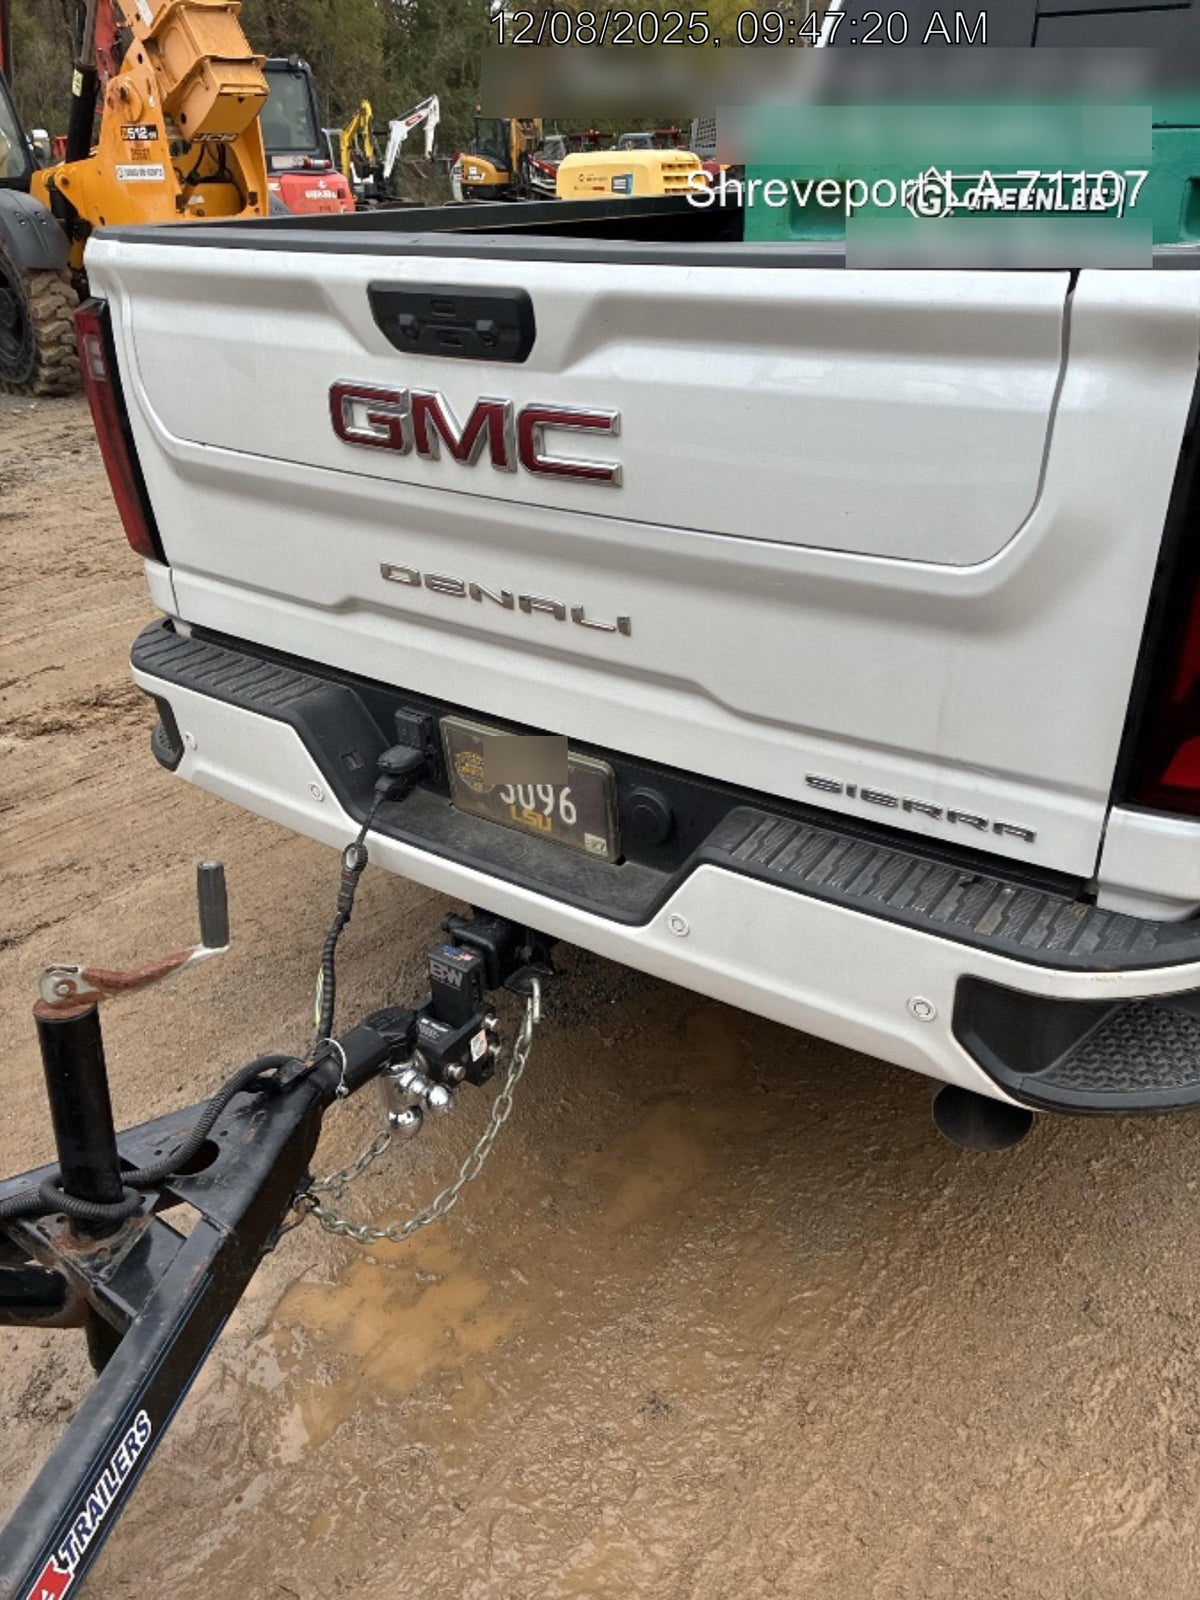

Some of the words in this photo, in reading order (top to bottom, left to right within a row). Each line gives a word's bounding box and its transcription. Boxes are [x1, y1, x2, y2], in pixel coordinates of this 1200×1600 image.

[328, 378, 623, 487] GMC
[380, 562, 632, 636] DENALI
[511, 804, 552, 832] LSU
[804, 773, 1037, 844] SIERRA
[57, 1409, 152, 1570] TRAILERS
